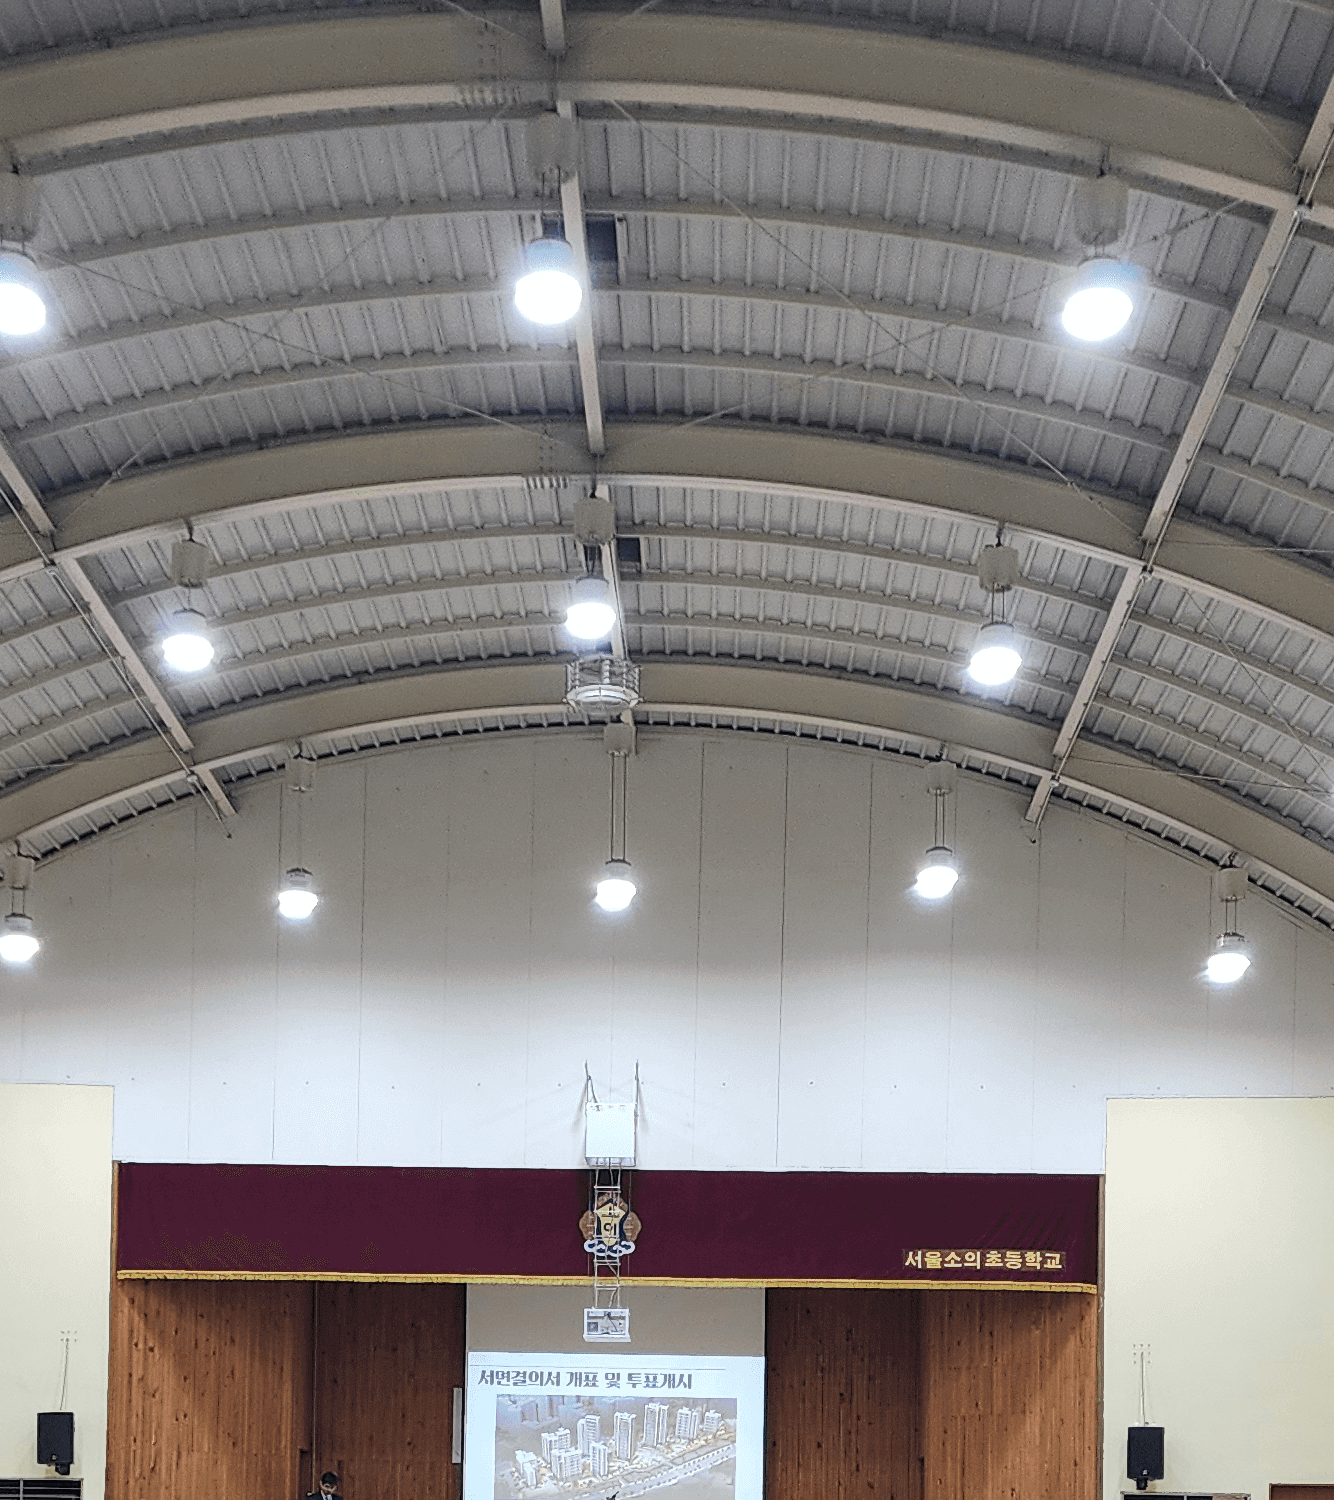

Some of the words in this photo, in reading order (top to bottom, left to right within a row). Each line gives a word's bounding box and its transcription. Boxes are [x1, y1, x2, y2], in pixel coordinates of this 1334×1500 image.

[477, 1370, 561, 1387] 서면결의서
[566, 1371, 599, 1388] 개표
[604, 1373, 621, 1389] 및
[626, 1373, 693, 1389] 투표개시
